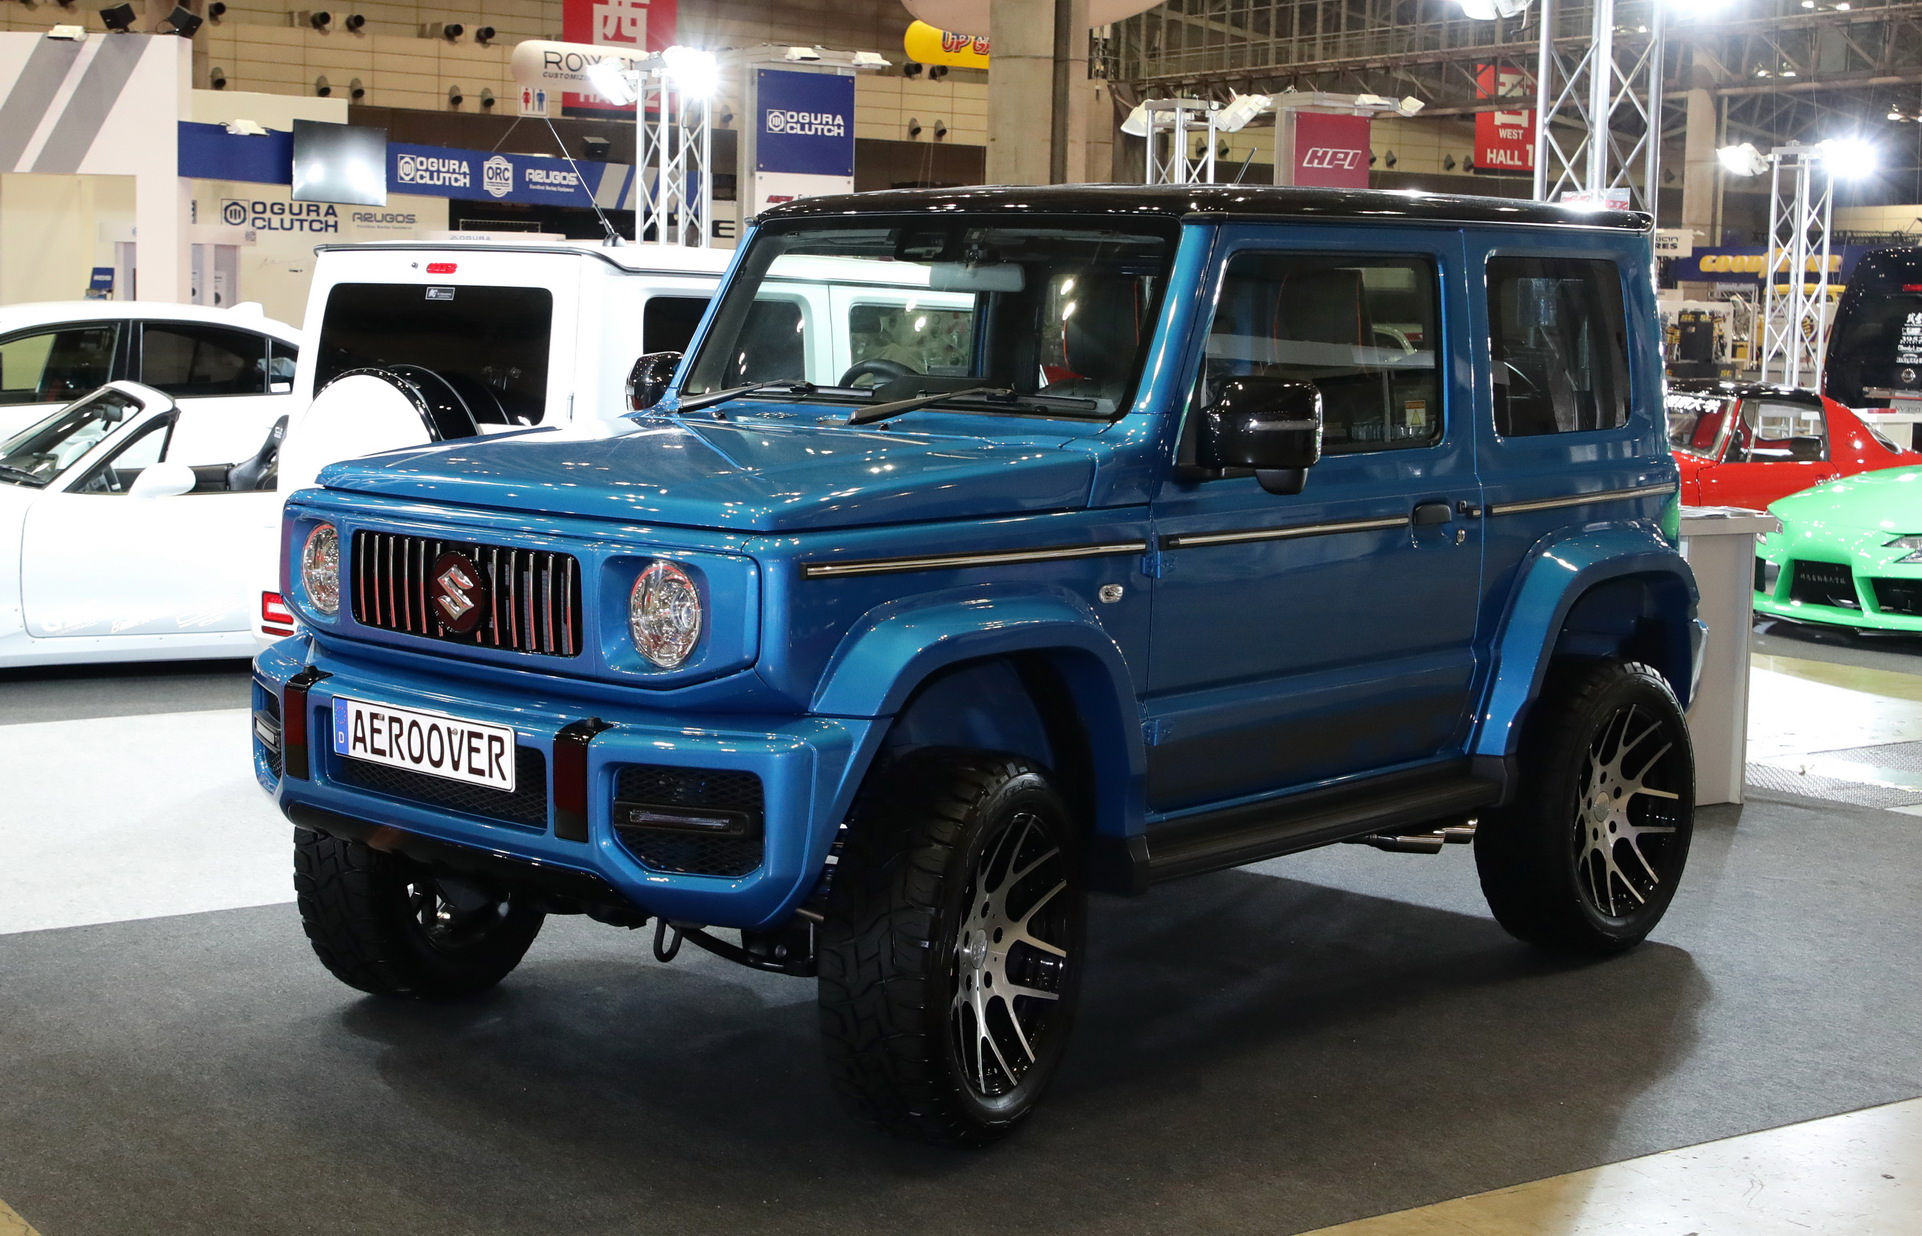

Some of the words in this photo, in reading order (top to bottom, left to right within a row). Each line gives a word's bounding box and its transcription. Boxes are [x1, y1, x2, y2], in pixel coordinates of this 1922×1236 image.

[786, 111, 845, 126] OGURA
[786, 123, 845, 137] CLUTCH
[1498, 128, 1524, 140] WEST
[1302, 147, 1362, 169] HPI
[1486, 148, 1522, 166] HALL
[1525, 144, 1534, 167] 1
[416, 157, 470, 173] OGURA
[416, 171, 470, 188] CLUTCH
[486, 166, 510, 182] ORC
[251, 201, 338, 218] OGURA
[251, 216, 338, 233] CLUTCH
[338, 731, 345, 743] D
[352, 709, 507, 781] AEROOVER
